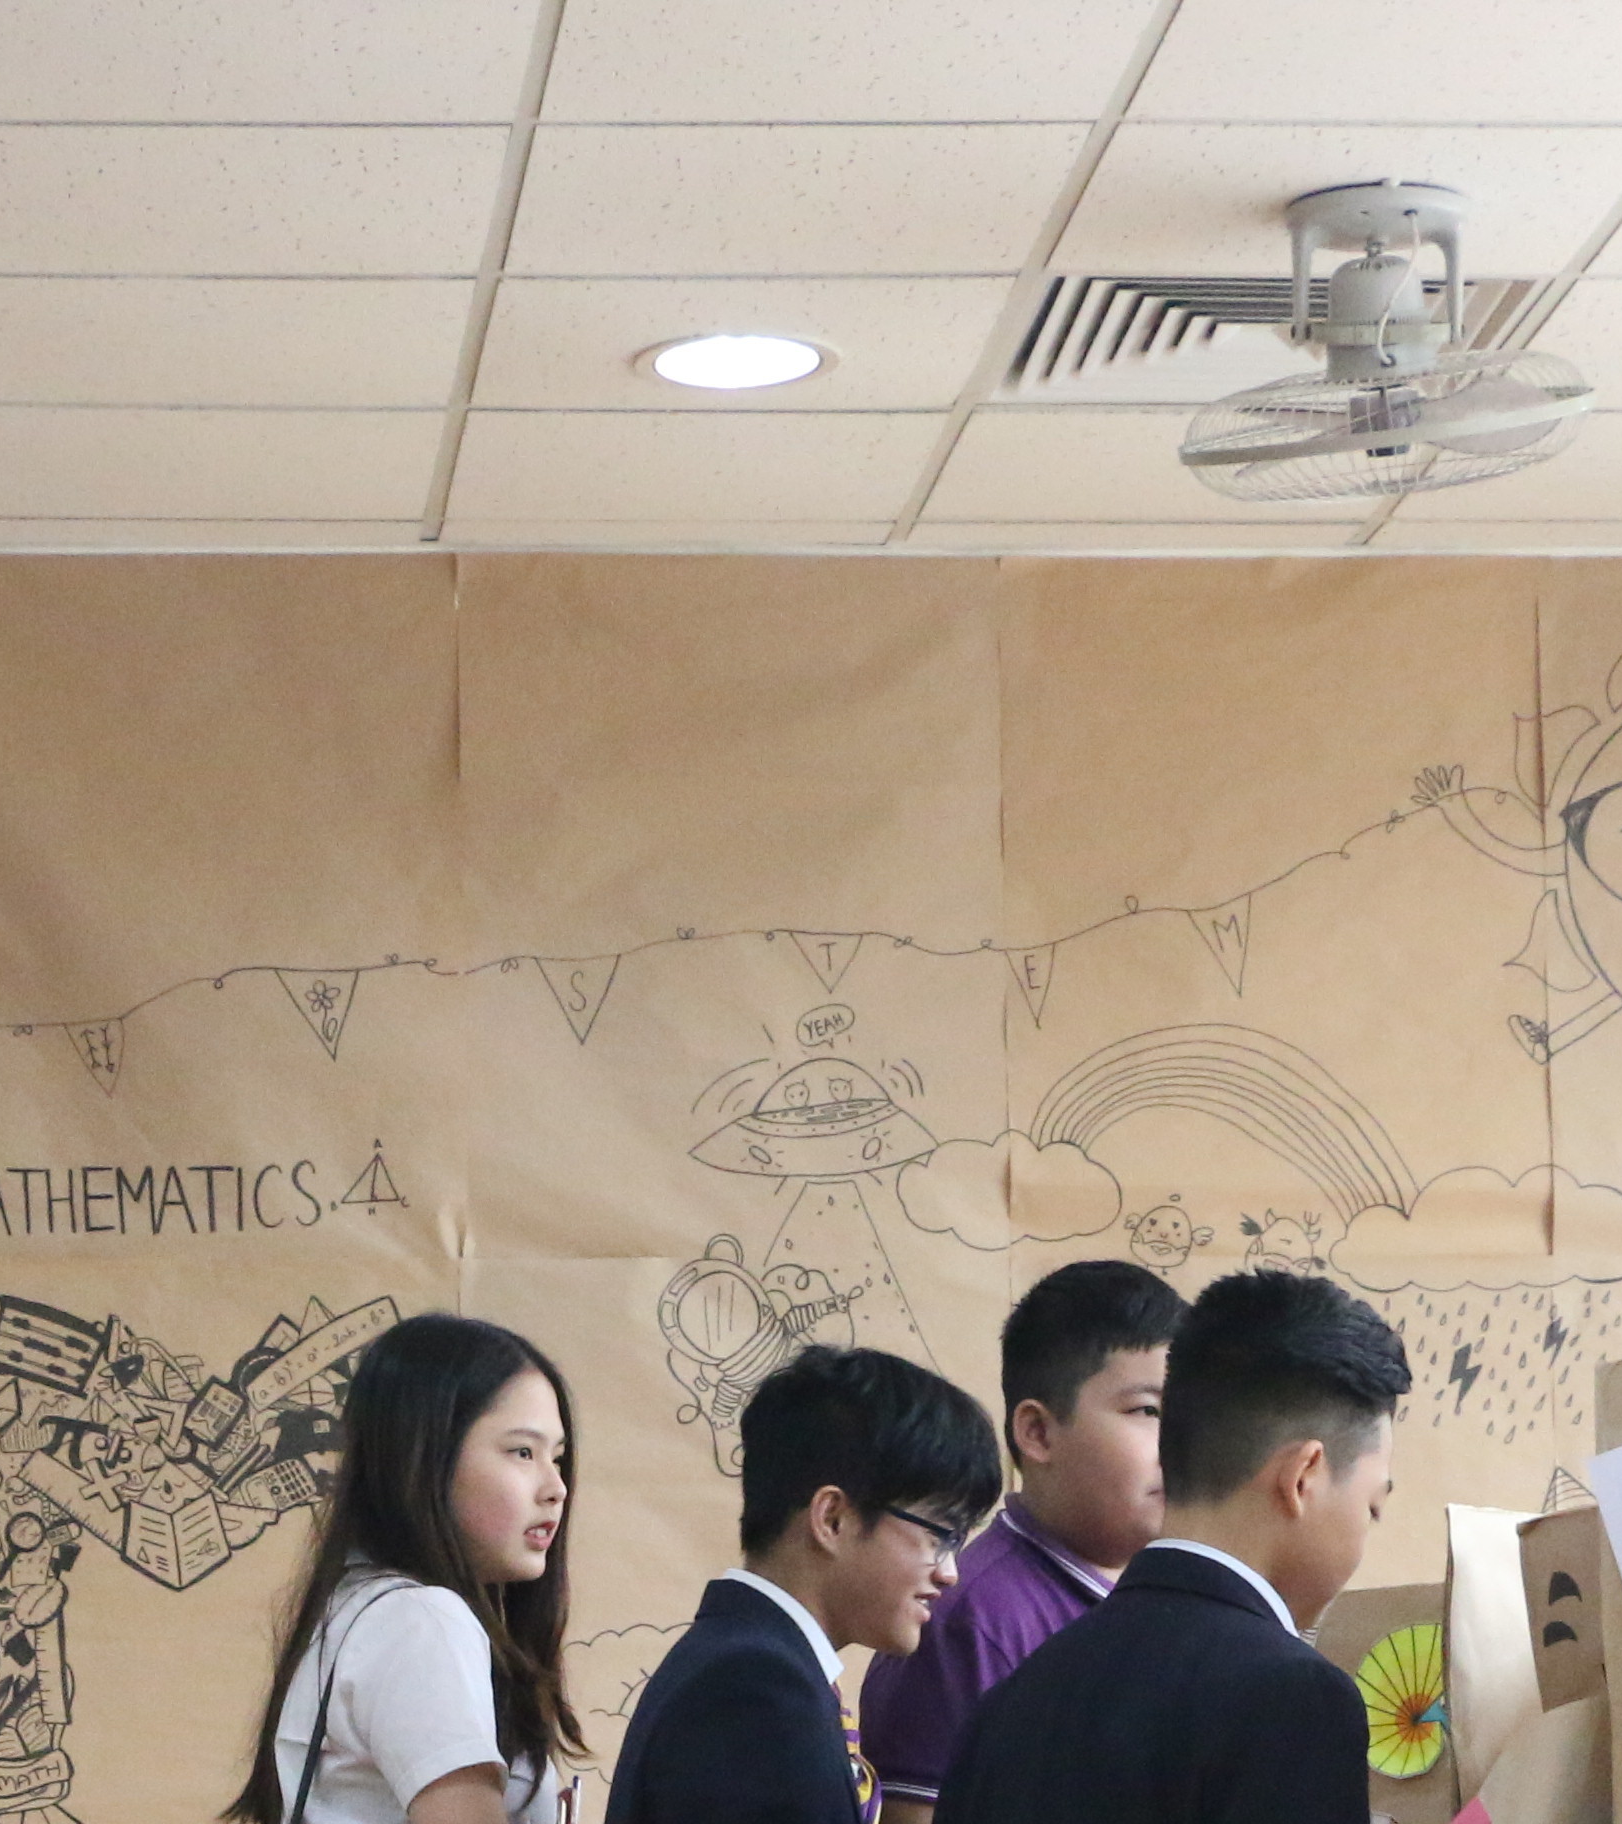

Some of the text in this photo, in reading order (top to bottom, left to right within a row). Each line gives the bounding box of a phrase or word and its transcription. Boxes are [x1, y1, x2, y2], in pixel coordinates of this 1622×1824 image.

[818, 942, 838, 972] T
[1023, 953, 1042, 991] E
[1212, 915, 1244, 952] M
[803, 1011, 847, 1042] YEAH
